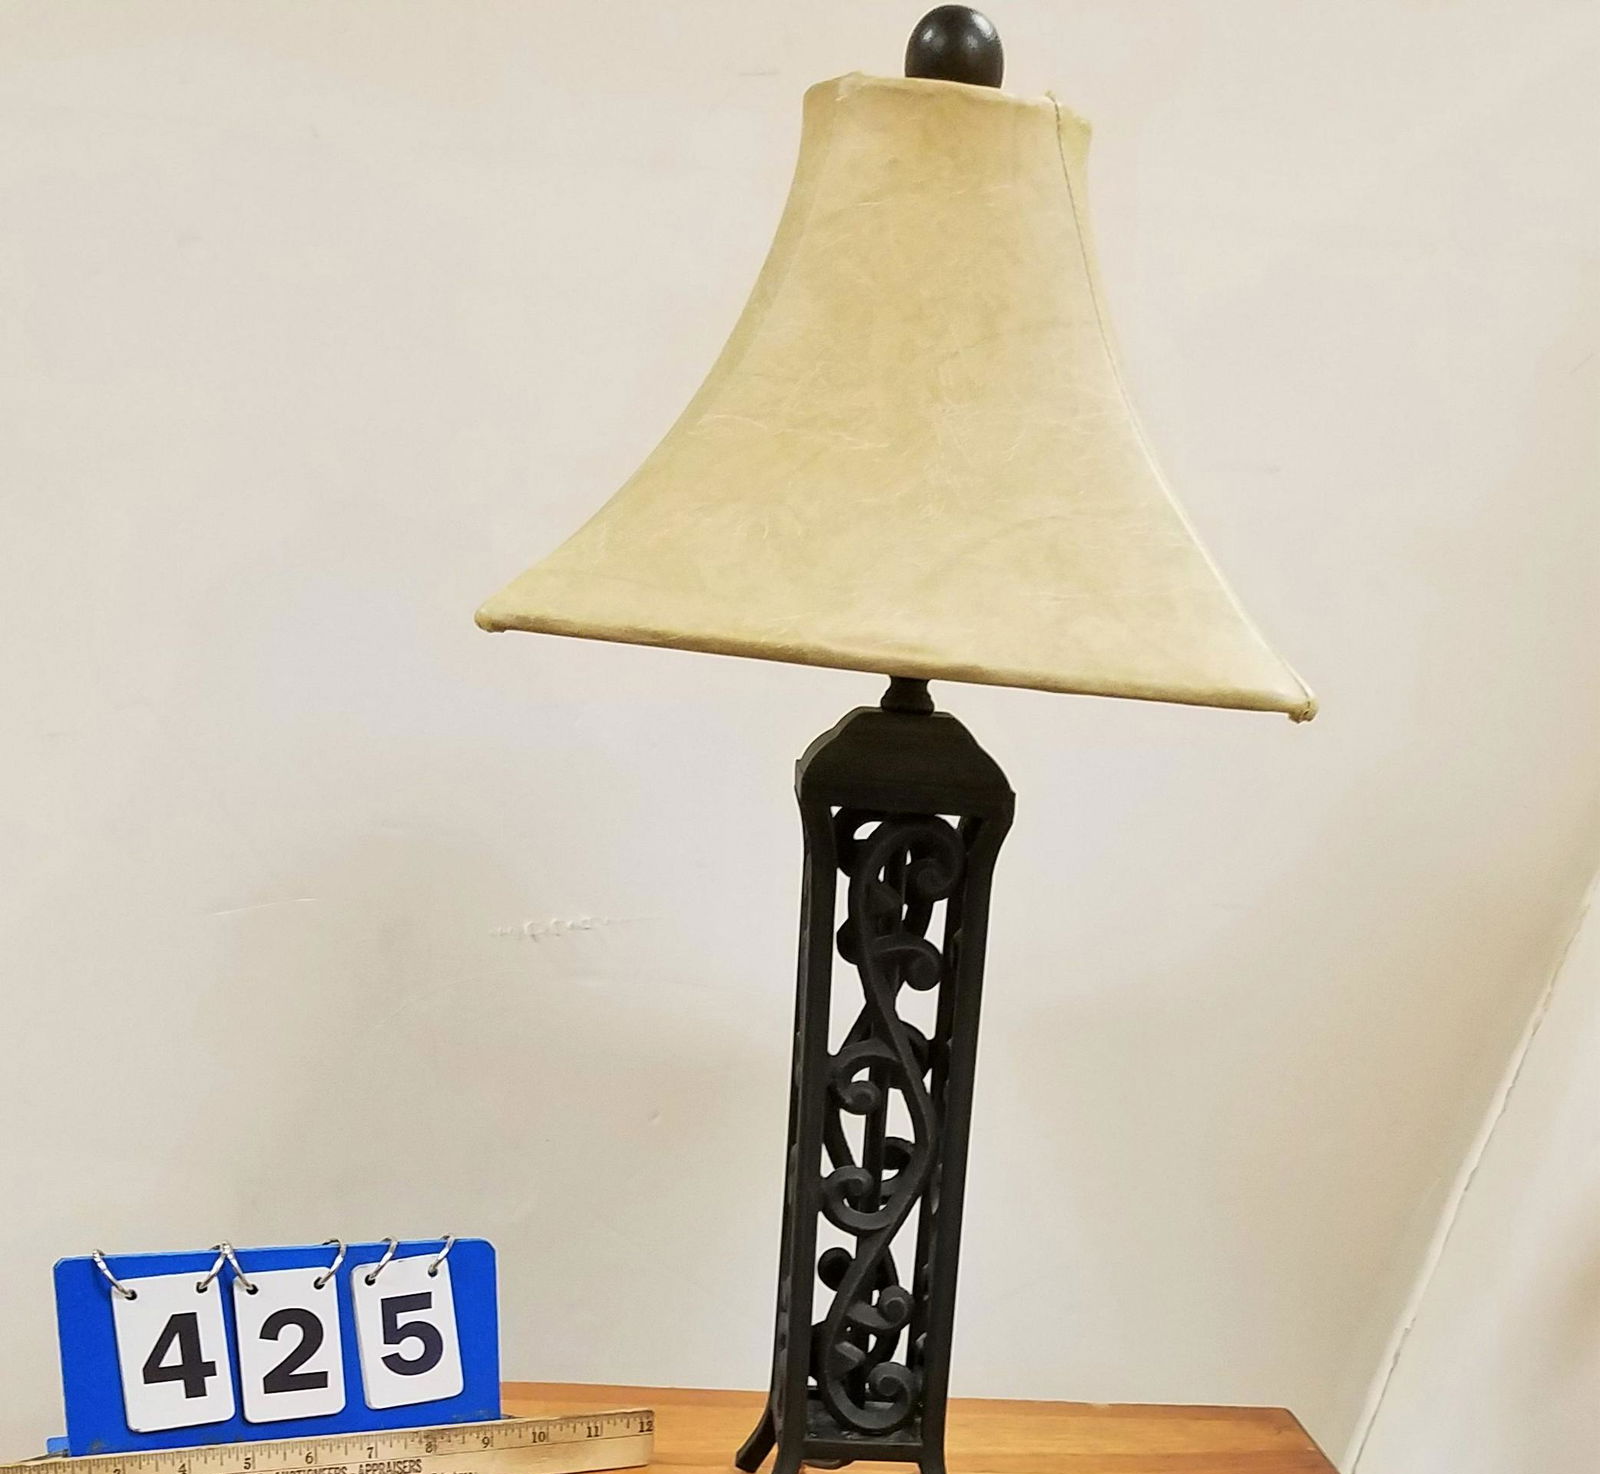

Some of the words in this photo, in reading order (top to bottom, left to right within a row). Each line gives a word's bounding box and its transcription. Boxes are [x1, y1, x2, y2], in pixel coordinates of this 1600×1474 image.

[142, 1291, 444, 1399] 425
[243, 1457, 252, 1470] 5
[305, 1451, 314, 1464] 6
[367, 1447, 374, 1459] 7
[425, 1442, 433, 1453] 8
[482, 1437, 490, 1448] 9
[531, 1431, 546, 1443] 10
[586, 1425, 600, 1438] 11
[638, 1421, 653, 1433] 12
